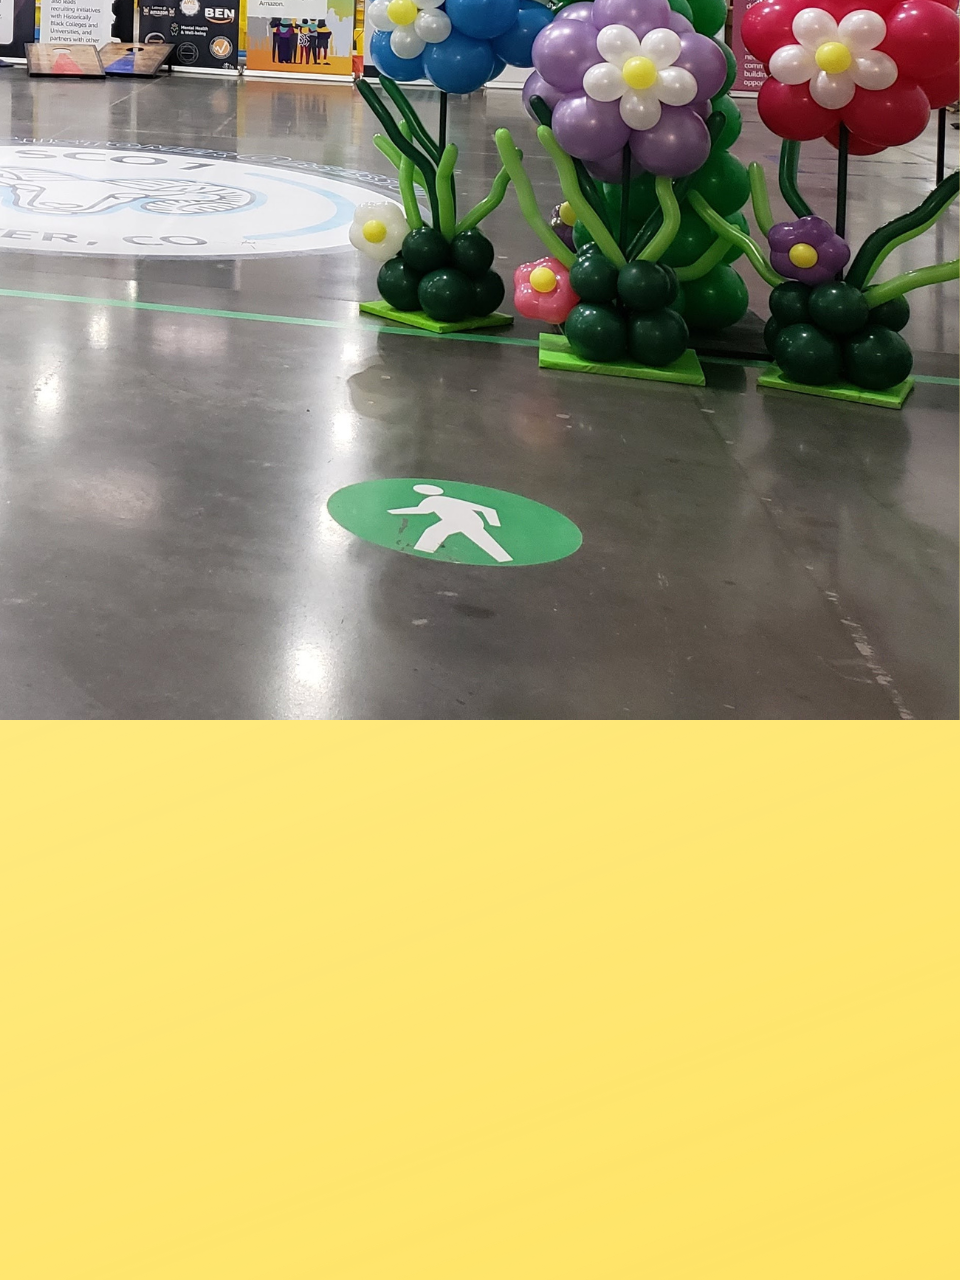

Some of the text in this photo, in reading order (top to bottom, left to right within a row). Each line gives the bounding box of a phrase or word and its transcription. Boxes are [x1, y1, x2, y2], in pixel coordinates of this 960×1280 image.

[204, 8, 235, 18] BEN
[14, 148, 216, 173] SCO1
[122, 234, 208, 246] CO
